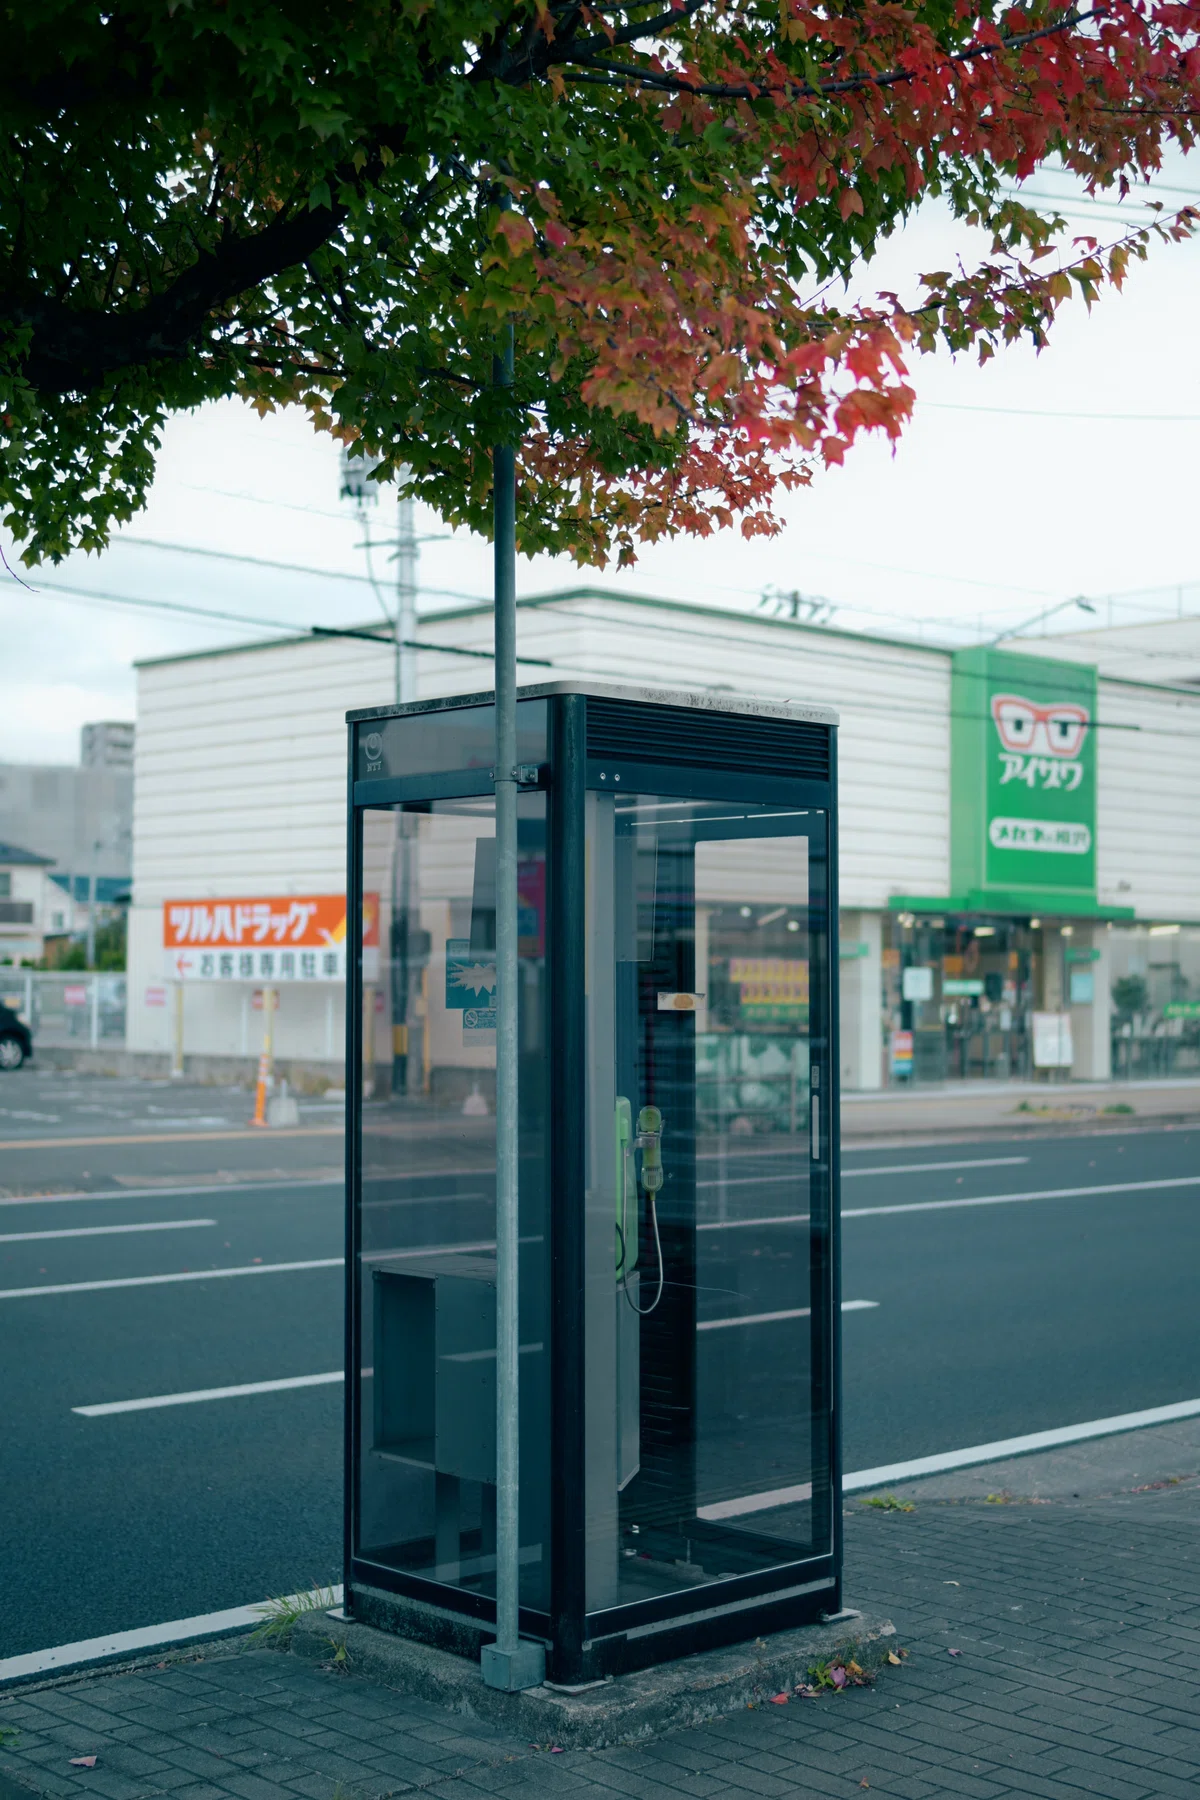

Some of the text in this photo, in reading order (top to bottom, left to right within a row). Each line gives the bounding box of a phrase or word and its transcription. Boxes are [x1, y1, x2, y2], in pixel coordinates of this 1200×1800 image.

[366, 761, 382, 773] NTT
[169, 903, 318, 943] ツルハドラッグ
[200, 952, 346, 979] お客様専用駐車
